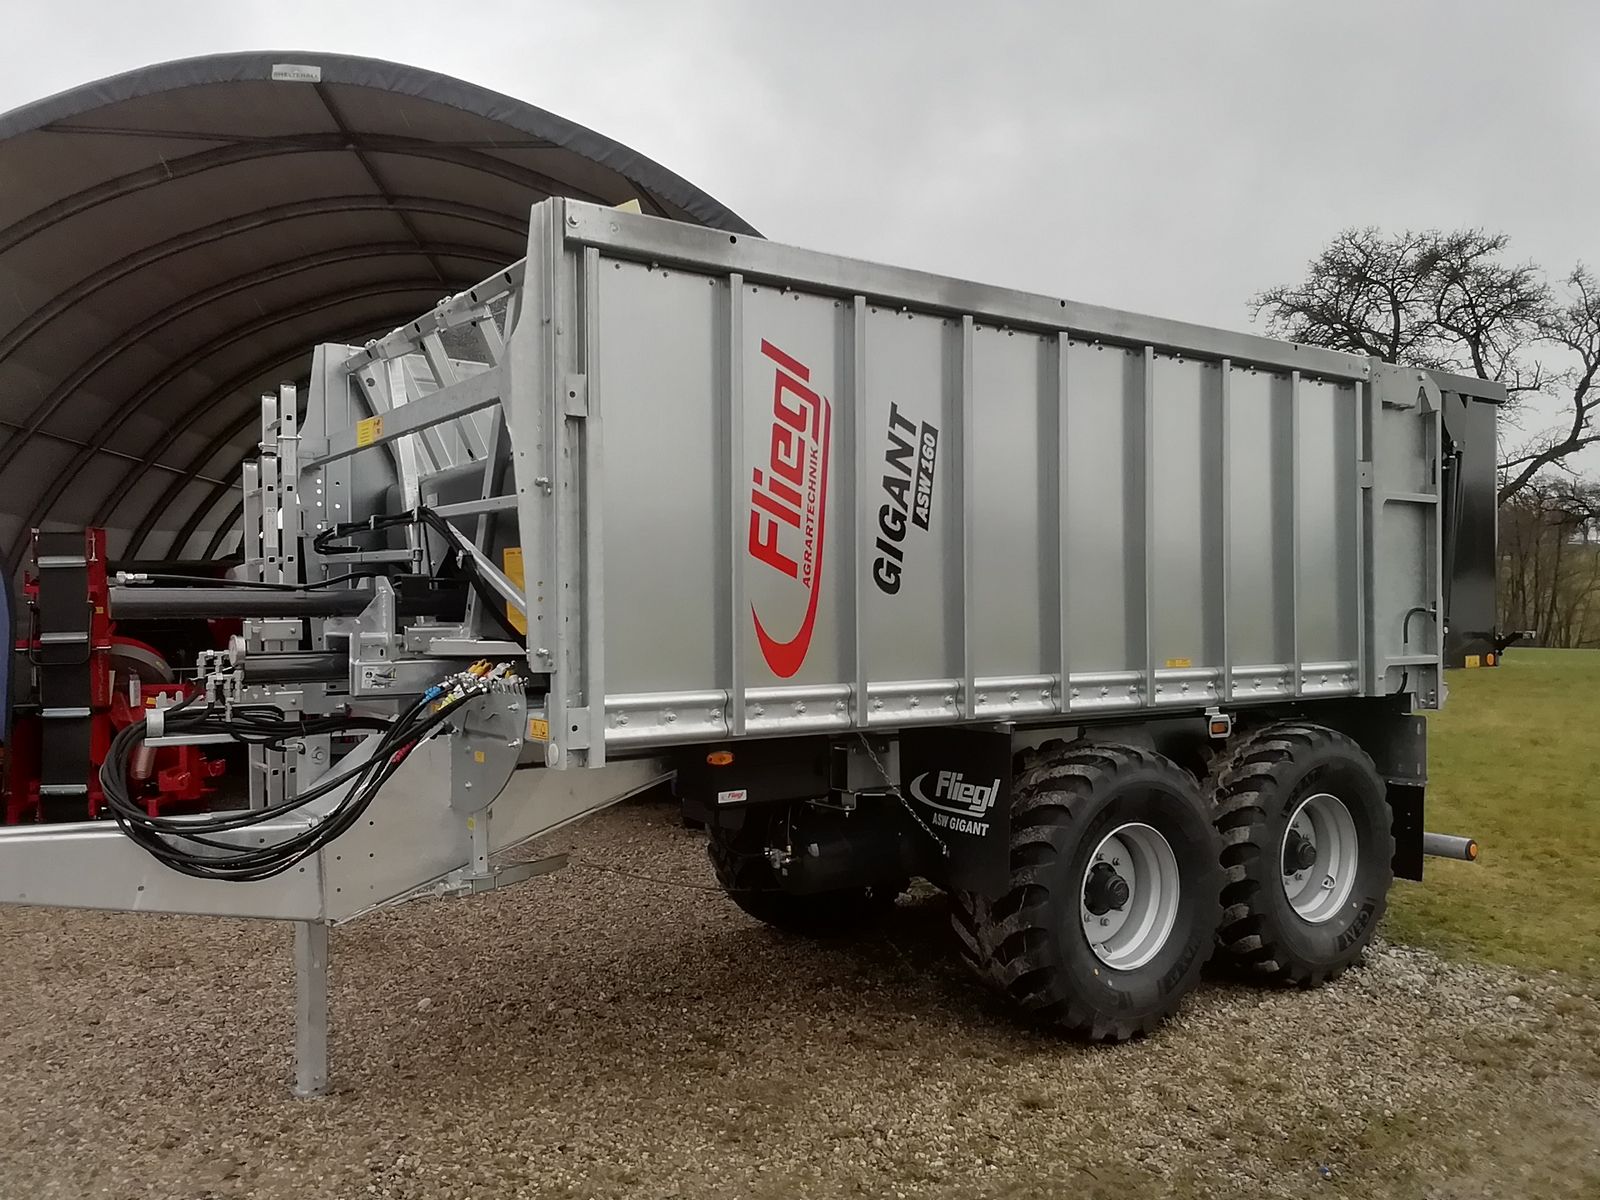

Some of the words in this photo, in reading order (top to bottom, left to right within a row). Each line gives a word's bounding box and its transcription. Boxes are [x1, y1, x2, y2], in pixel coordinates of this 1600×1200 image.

[749, 337, 821, 580] Fliegl
[920, 432, 937, 472] 160
[802, 446, 819, 589] AGRARTECHNIK
[872, 401, 917, 595] GIGANT
[915, 472, 933, 524] ASW
[935, 770, 1001, 812] Fliegl
[932, 812, 950, 827] ASW
[949, 817, 990, 837] GIGANT
